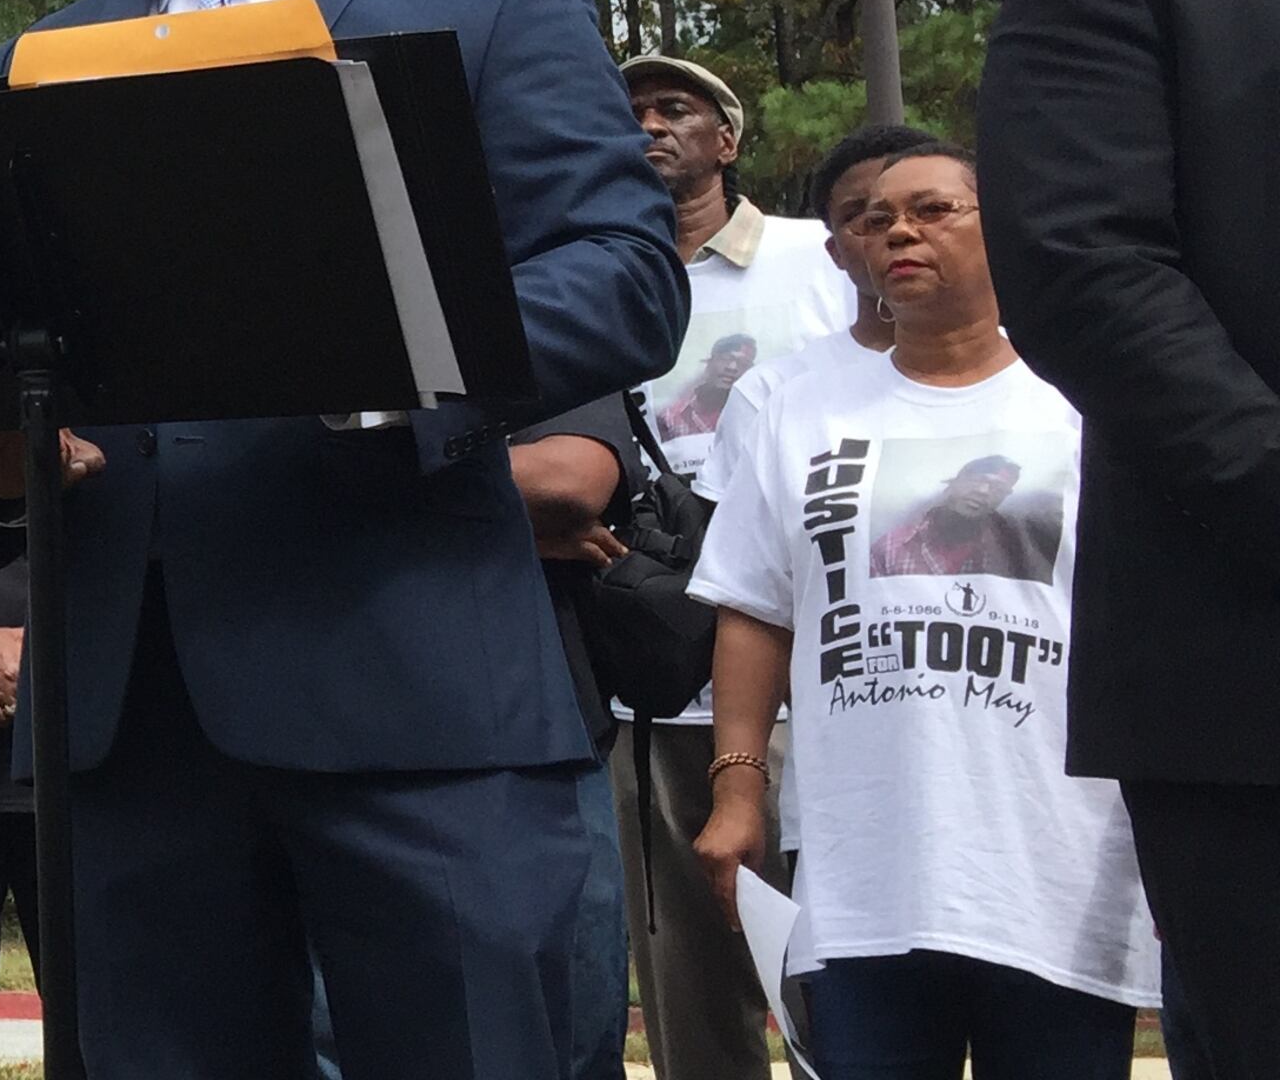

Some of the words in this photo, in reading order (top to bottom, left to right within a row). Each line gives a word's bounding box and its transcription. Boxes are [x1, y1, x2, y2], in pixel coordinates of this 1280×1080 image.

[803, 438, 871, 685] JUSTICE
[988, 611, 1040, 629] 9-11-18
[866, 654, 900, 674] FOR
[829, 672, 946, 715] Antonio
[964, 675, 1036, 728] May
